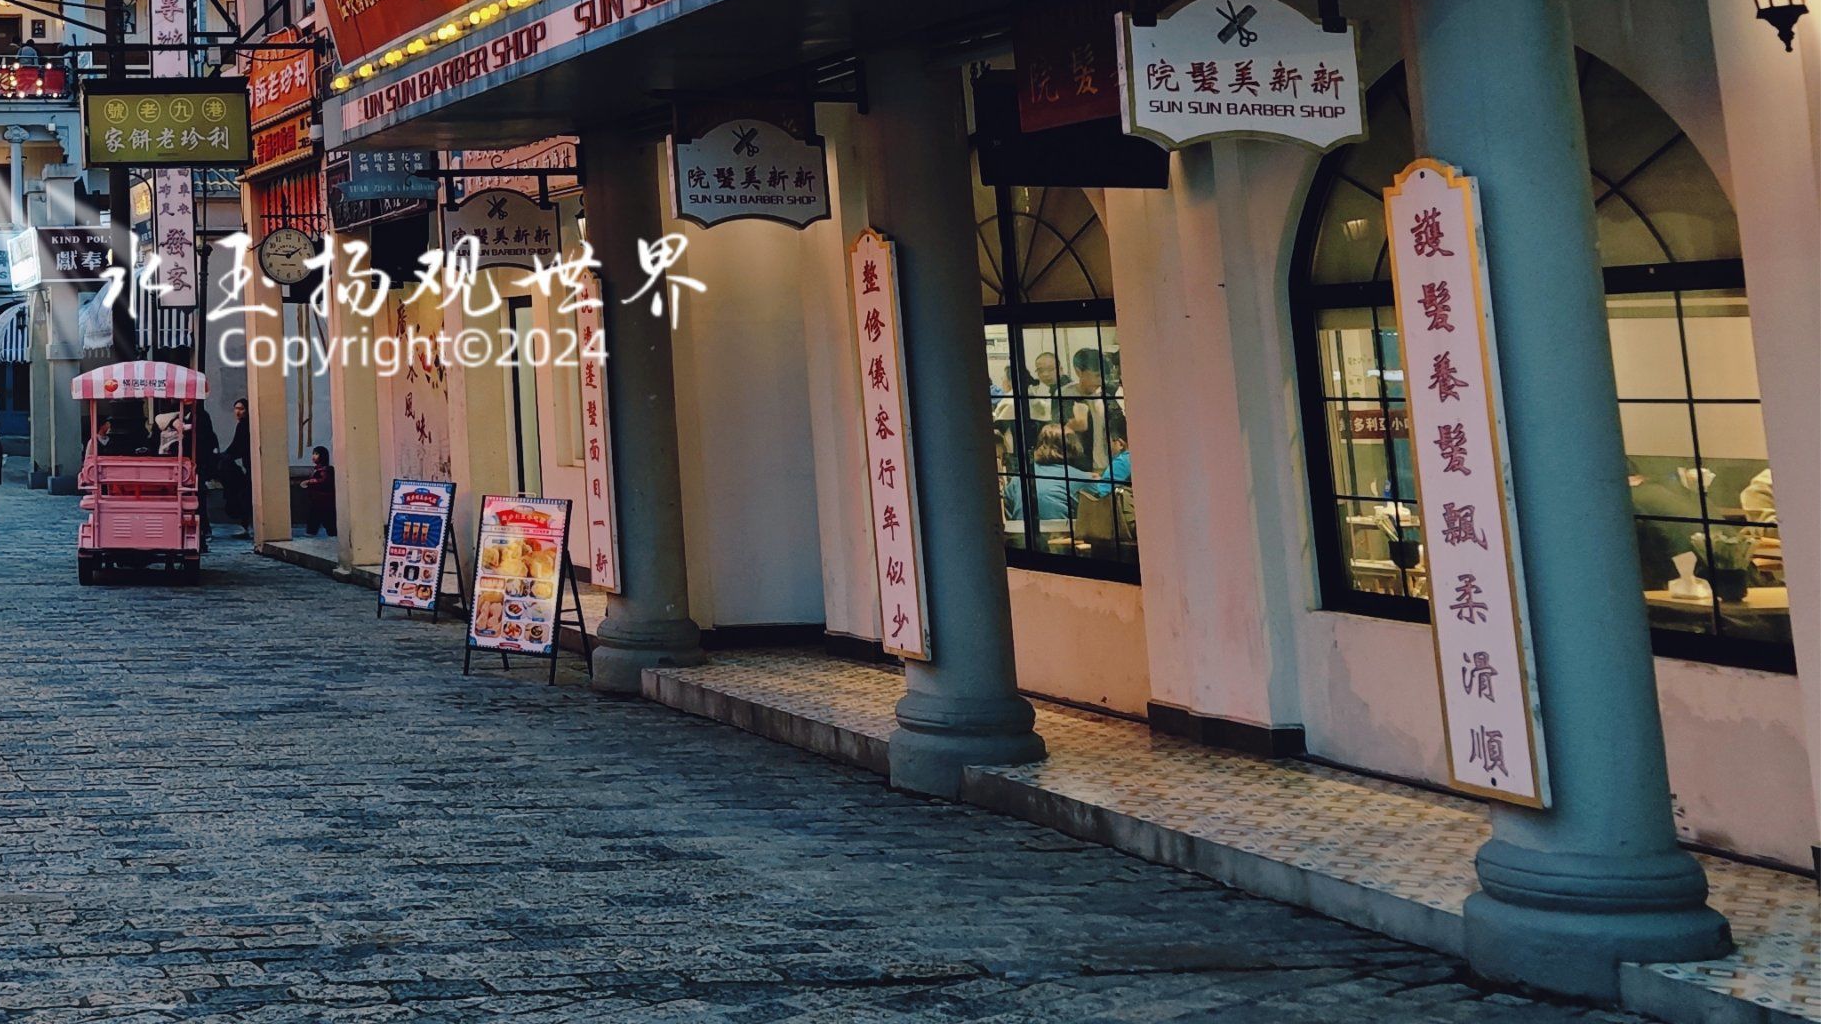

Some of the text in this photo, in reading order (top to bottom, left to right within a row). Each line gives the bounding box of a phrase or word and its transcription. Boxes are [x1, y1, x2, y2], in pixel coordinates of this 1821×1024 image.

[386, 83, 416, 113] SUN
[418, 51, 488, 100] BARBER
[491, 22, 546, 74] SHOP
[1149, 100, 1345, 119] SUN SUN BARBER SHOP
[689, 194, 817, 205] SUN SUN BARBER SHOP
[51, 235, 80, 244] KIND
[491, 248, 526, 256] BARBER
[528, 248, 552, 256] SHOP
